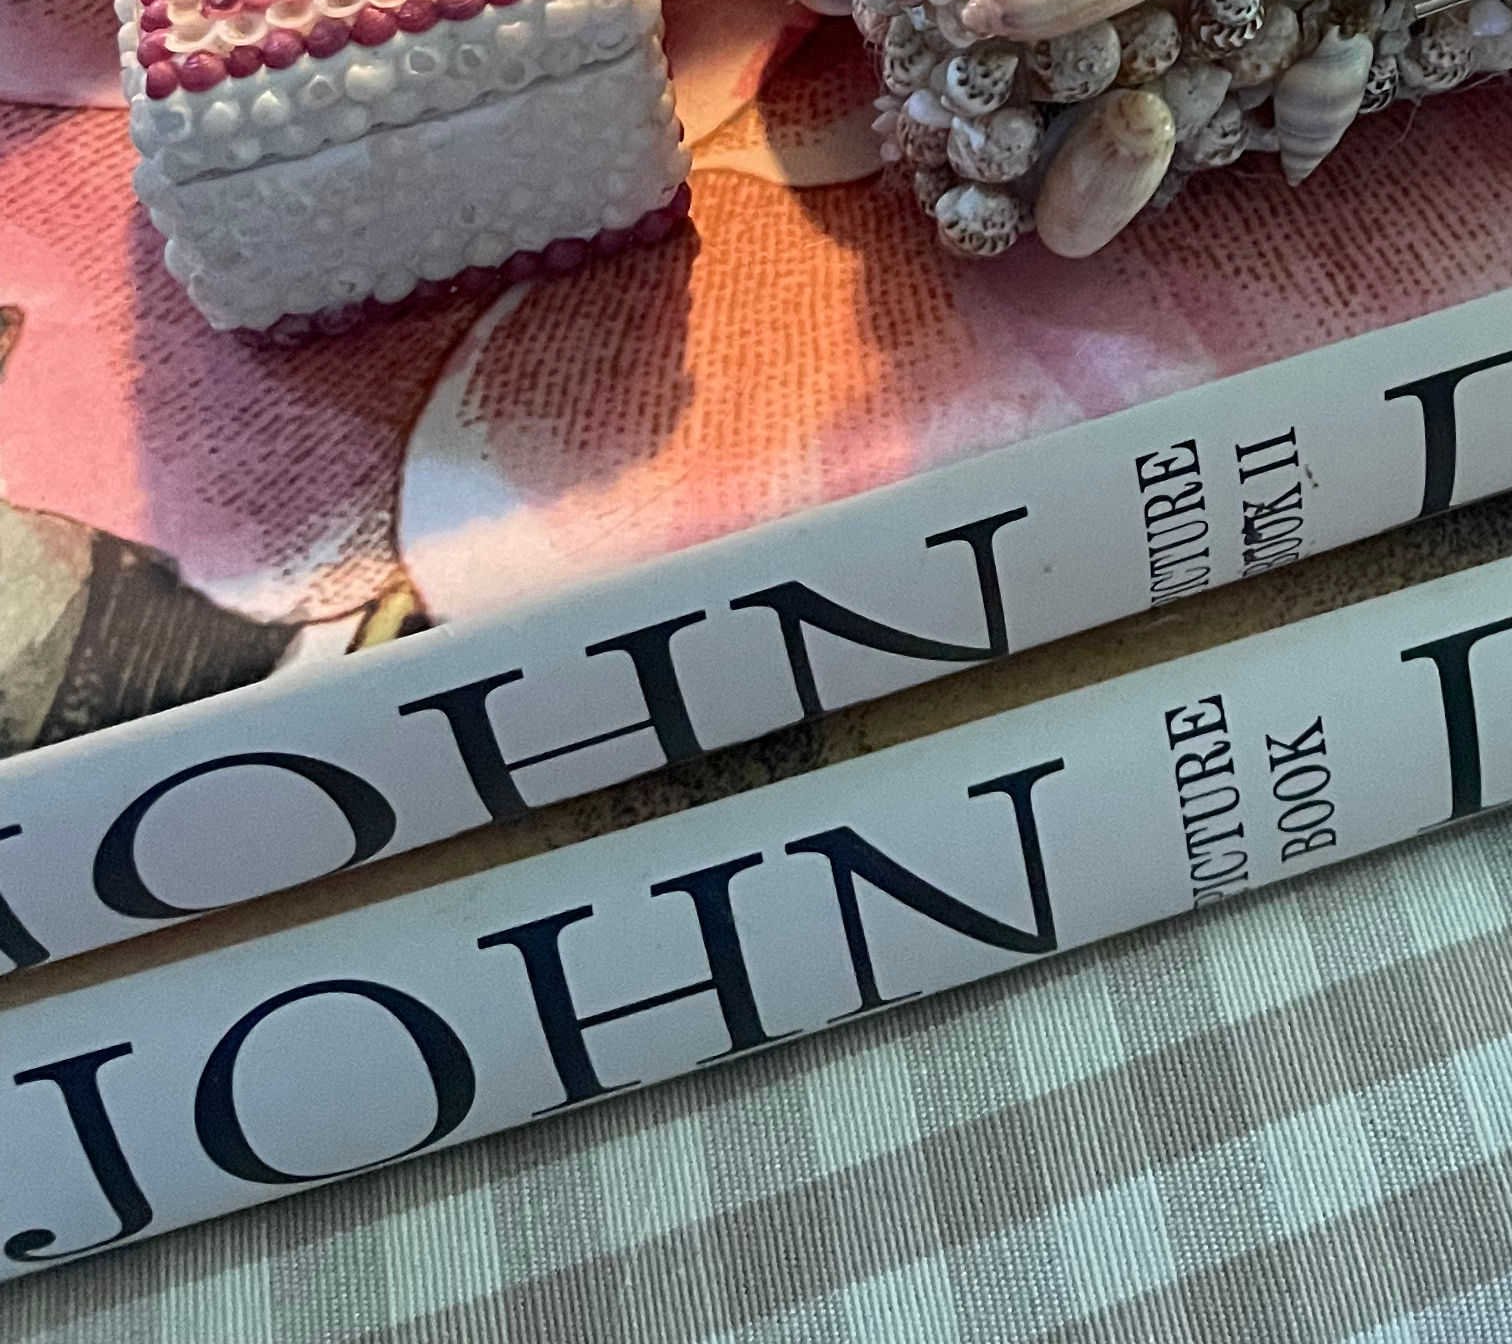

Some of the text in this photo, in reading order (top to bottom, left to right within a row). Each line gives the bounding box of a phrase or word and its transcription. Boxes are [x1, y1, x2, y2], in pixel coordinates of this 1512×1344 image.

[1135, 438, 1211, 605] ICTURE
[1235, 426, 1299, 484] II
[1265, 715, 1337, 863] BOOK
[2, 758, 1065, 1262] JOHN
